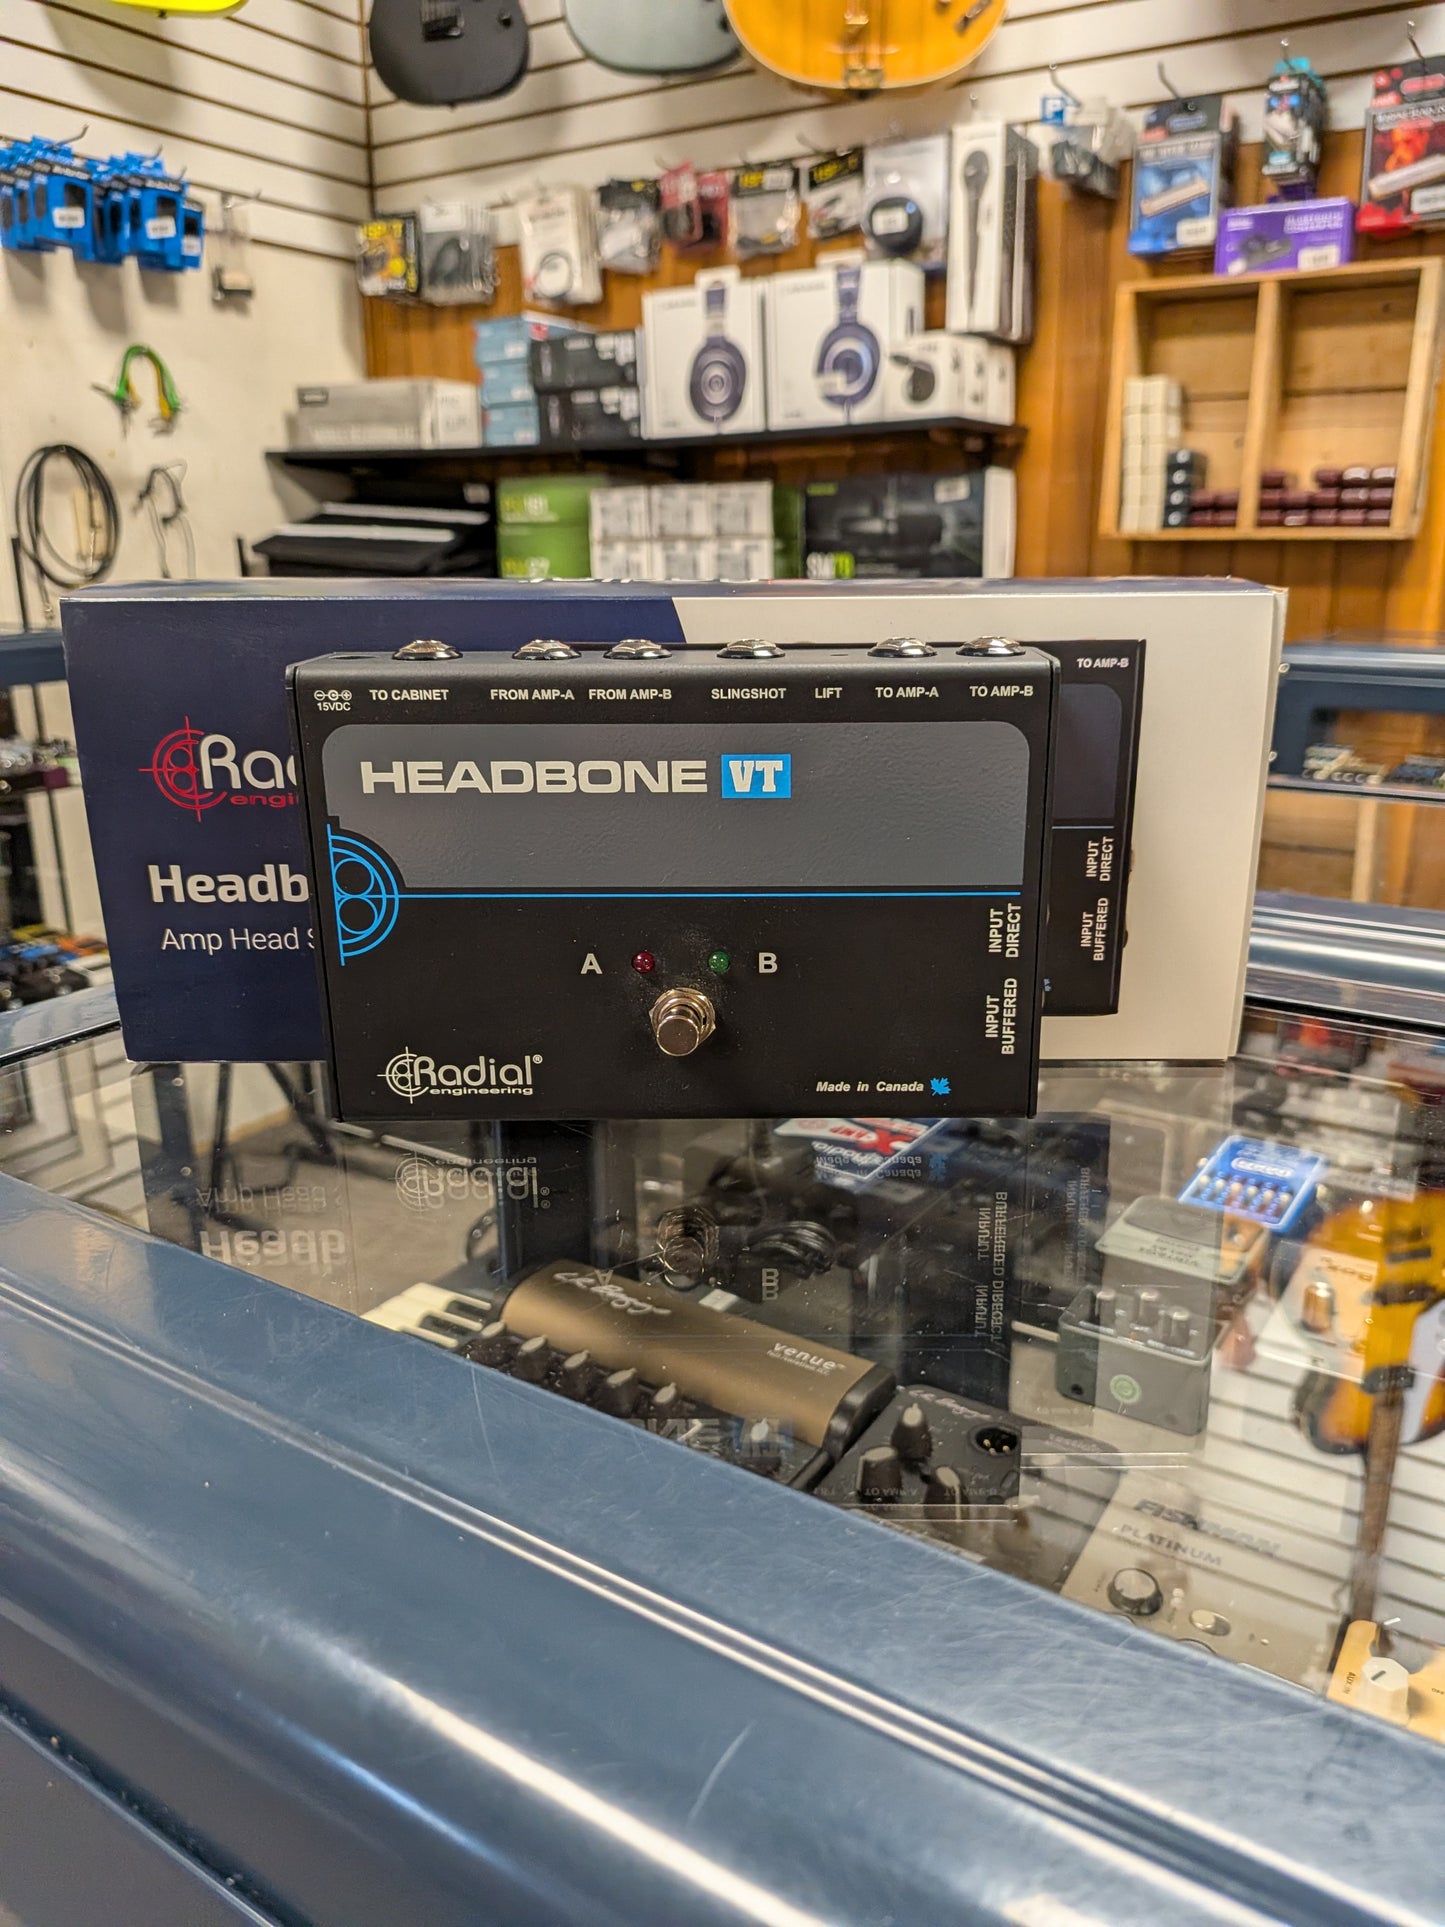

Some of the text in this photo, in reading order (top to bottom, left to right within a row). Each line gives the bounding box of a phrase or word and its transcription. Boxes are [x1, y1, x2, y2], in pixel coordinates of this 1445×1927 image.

[1076, 656, 1129, 668] TO AMP-B
[369, 688, 450, 701] TO CABINET
[490, 688, 575, 701] FROM AMP-A
[588, 687, 672, 701] FROM AMP-B
[710, 688, 787, 700] SLINGSHOT
[814, 687, 843, 699] LIFT
[875, 686, 939, 699] TO AMP-A
[969, 685, 1034, 697] TO AMP-B
[316, 702, 352, 712] 15VDC
[359, 759, 784, 794] HEADBONE VT
[230, 792, 299, 808] engi
[1086, 840, 1099, 878] INPUT
[1100, 836, 1115, 881] DIRECT
[147, 864, 310, 903] Headb
[988, 908, 1004, 953] INPUT
[1005, 903, 1022, 958] DIRECT
[1080, 911, 1094, 947] INPUT
[1093, 897, 1109, 961] BUFFERED
[161, 928, 223, 956] Amp
[229, 926, 300, 950] Head
[580, 952, 603, 975] A
[758, 952, 779, 974] B
[985, 994, 1000, 1038] INPUT
[1001, 977, 1018, 1055] BUFFERED
[429, 1086, 534, 1096] engineering
[815, 1081, 925, 1093] Made in Canada
[1119, 1522, 1224, 1567] PLATINUM
